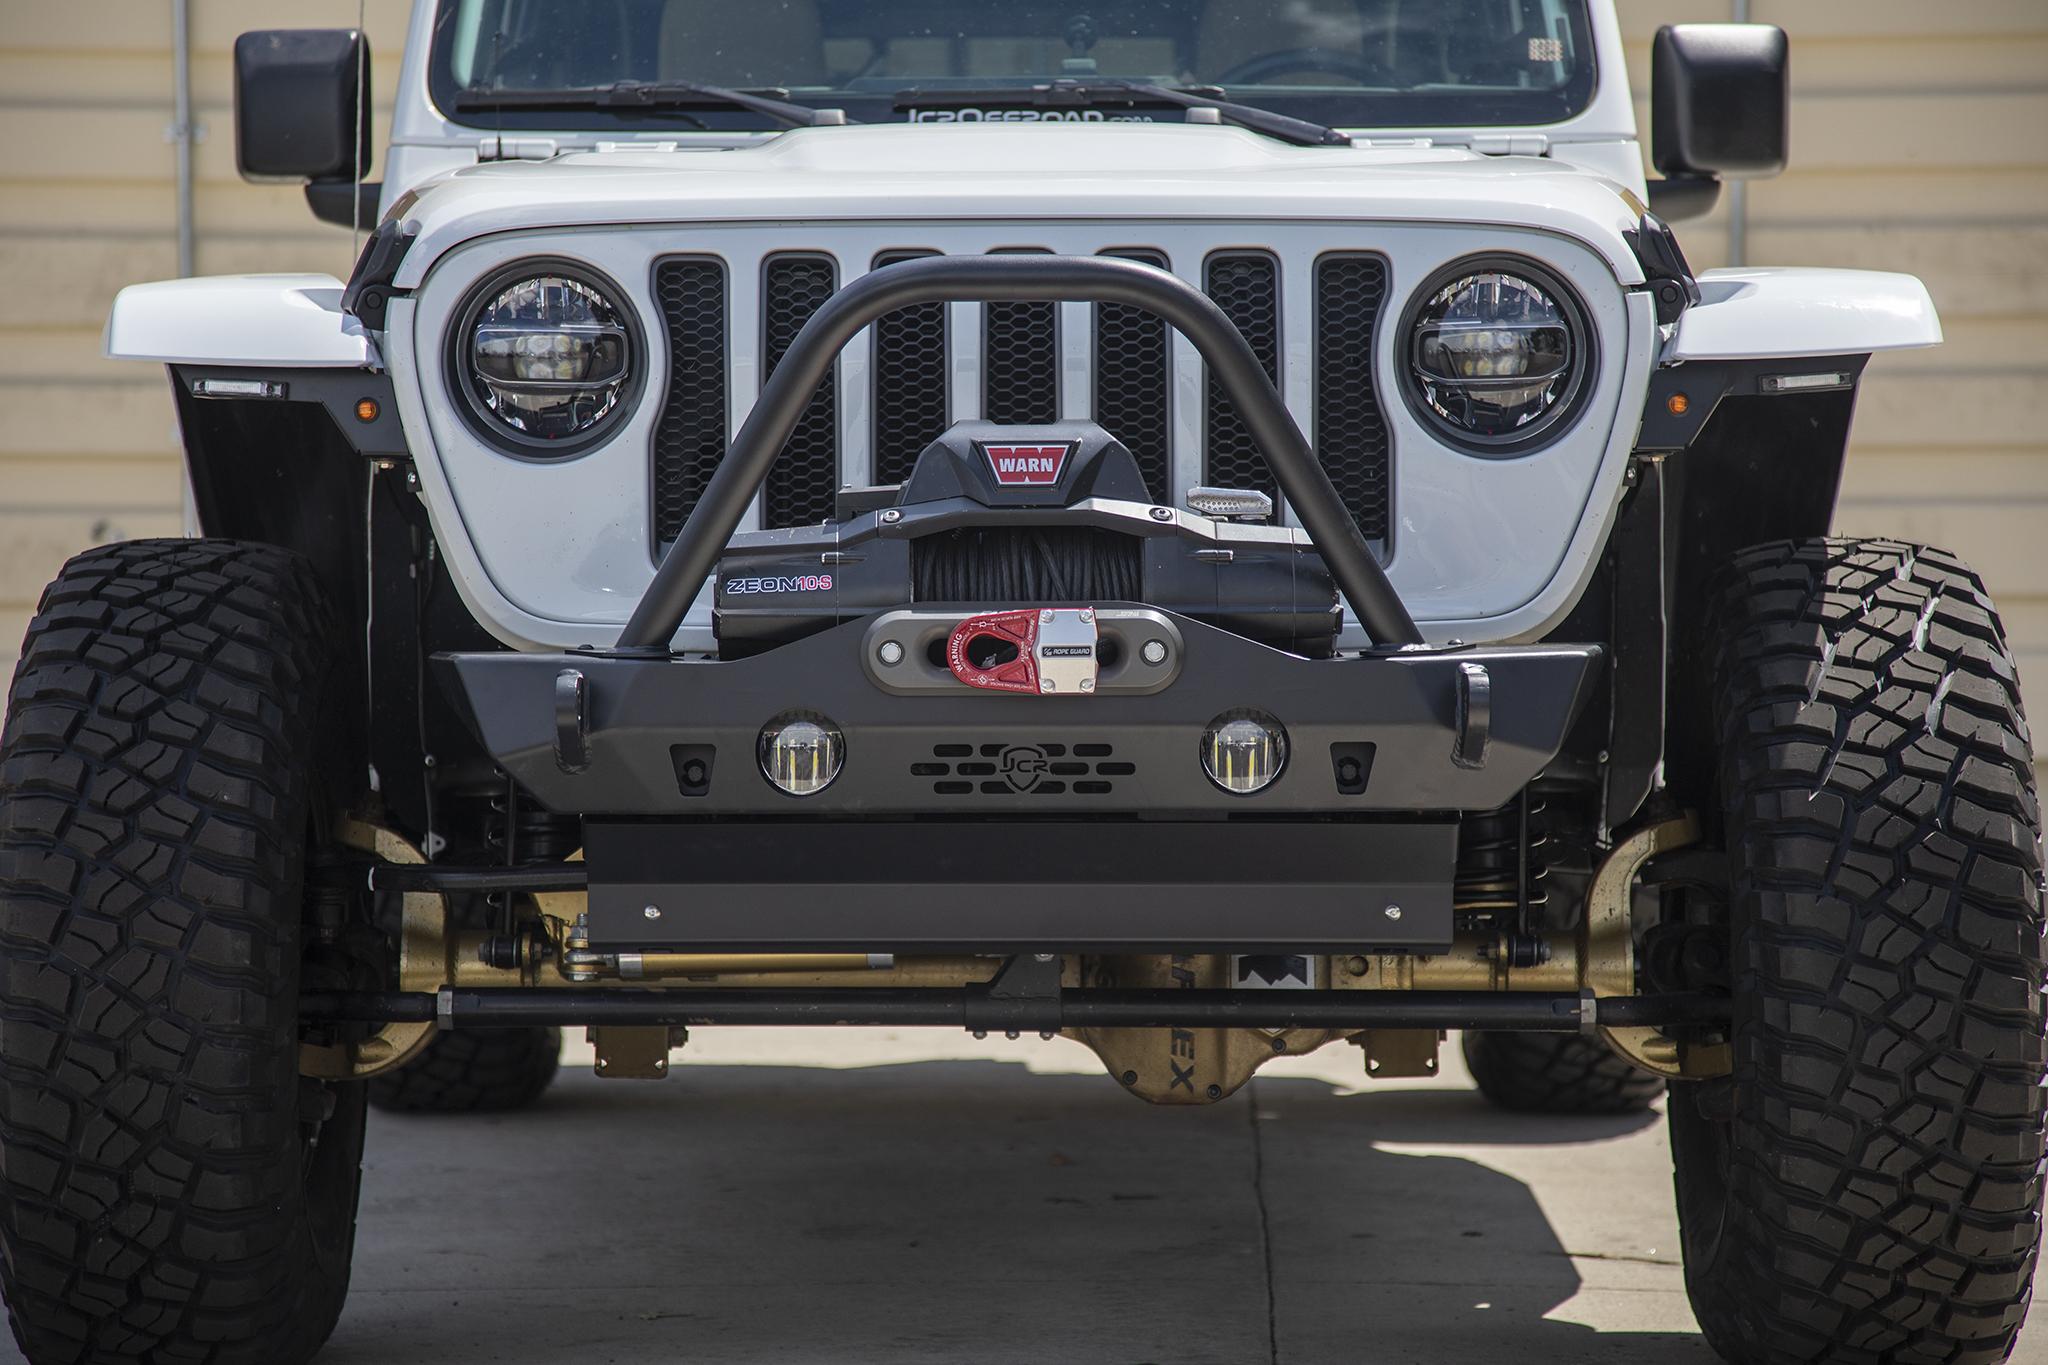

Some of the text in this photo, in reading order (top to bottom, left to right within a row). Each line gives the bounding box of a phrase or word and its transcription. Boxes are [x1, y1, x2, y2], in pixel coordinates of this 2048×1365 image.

[999, 458, 1054, 472] WARN
[951, 633, 963, 672] WARNING
[1000, 757, 1048, 773] JCR
